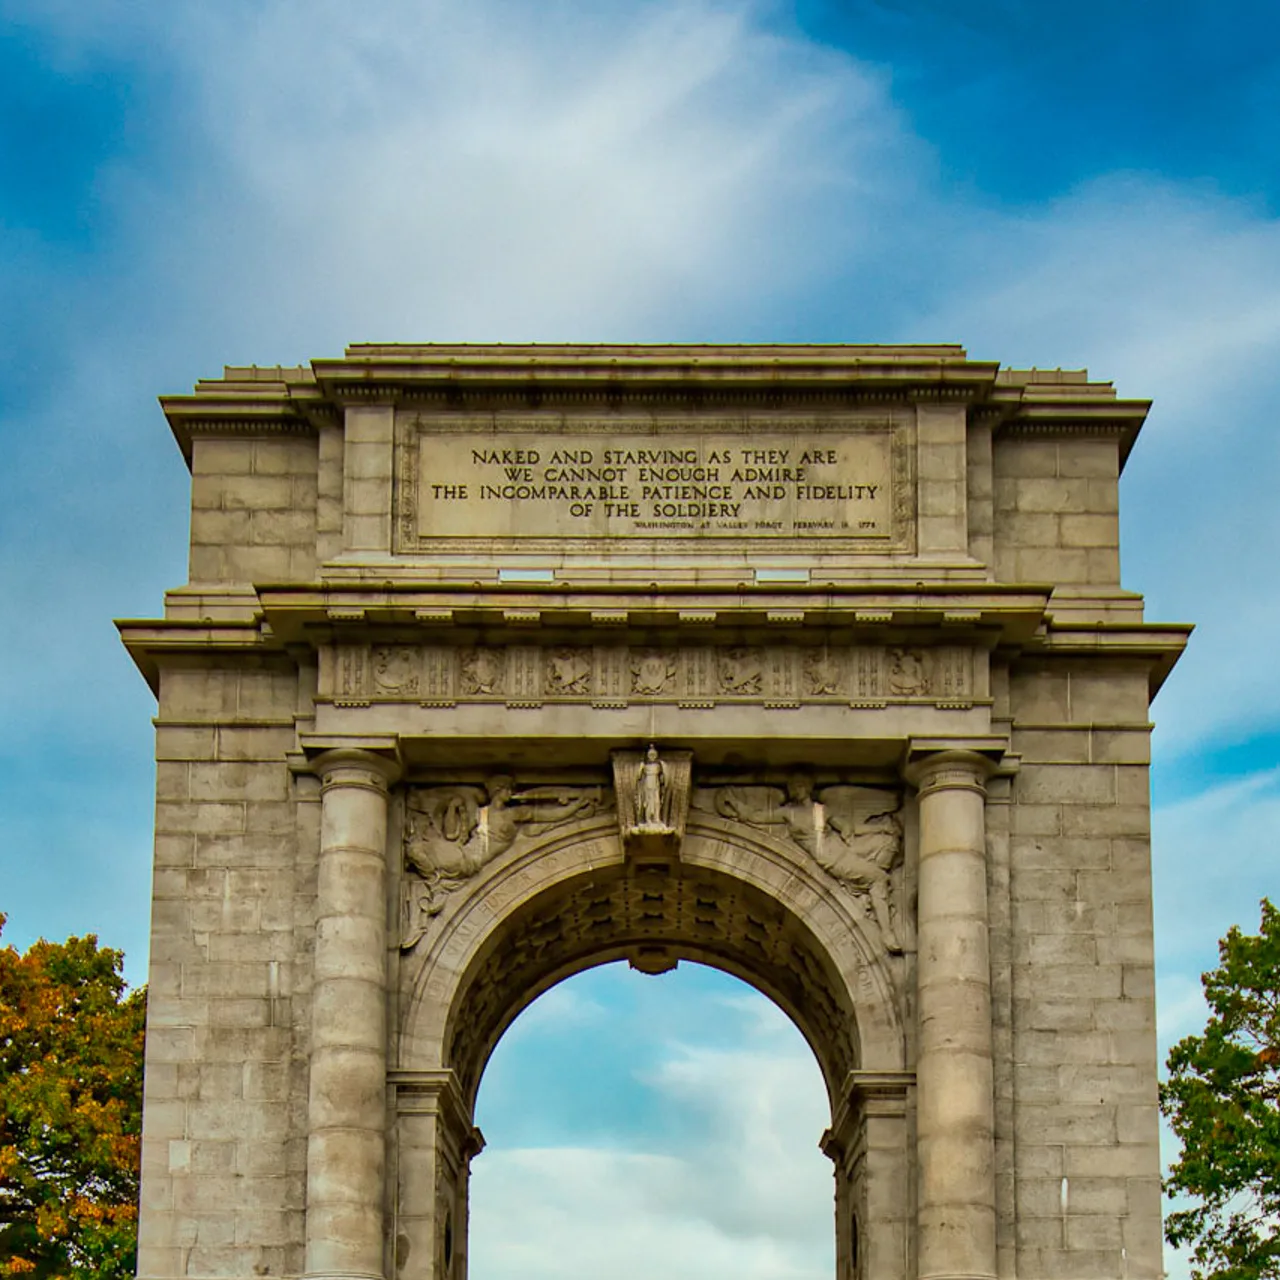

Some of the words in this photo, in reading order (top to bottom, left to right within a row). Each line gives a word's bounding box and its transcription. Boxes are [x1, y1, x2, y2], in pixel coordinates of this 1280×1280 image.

[472, 450, 540, 464] NAKED
[551, 450, 593, 464] AND
[604, 450, 697, 464] STARVING
[708, 450, 731, 464] AS
[741, 450, 790, 464] THEY
[800, 450, 837, 464] ARE
[504, 468, 533, 482] WE
[545, 468, 626, 482] CANNOT
[639, 468, 719, 482] ENOUGH
[731, 468, 806, 482] ADMIRE
[432, 485, 468, 500] THE
[480, 485, 629, 500] INCOMPARABLE
[643, 485, 733, 500] PATIENCE
[743, 485, 786, 500] AND
[797, 485, 878, 500] FIDELITY
[570, 503, 593, 518] OF
[605, 503, 640, 518] THE
[653, 503, 741, 518] SOLDIERY
[646, 663, 662, 677] W
